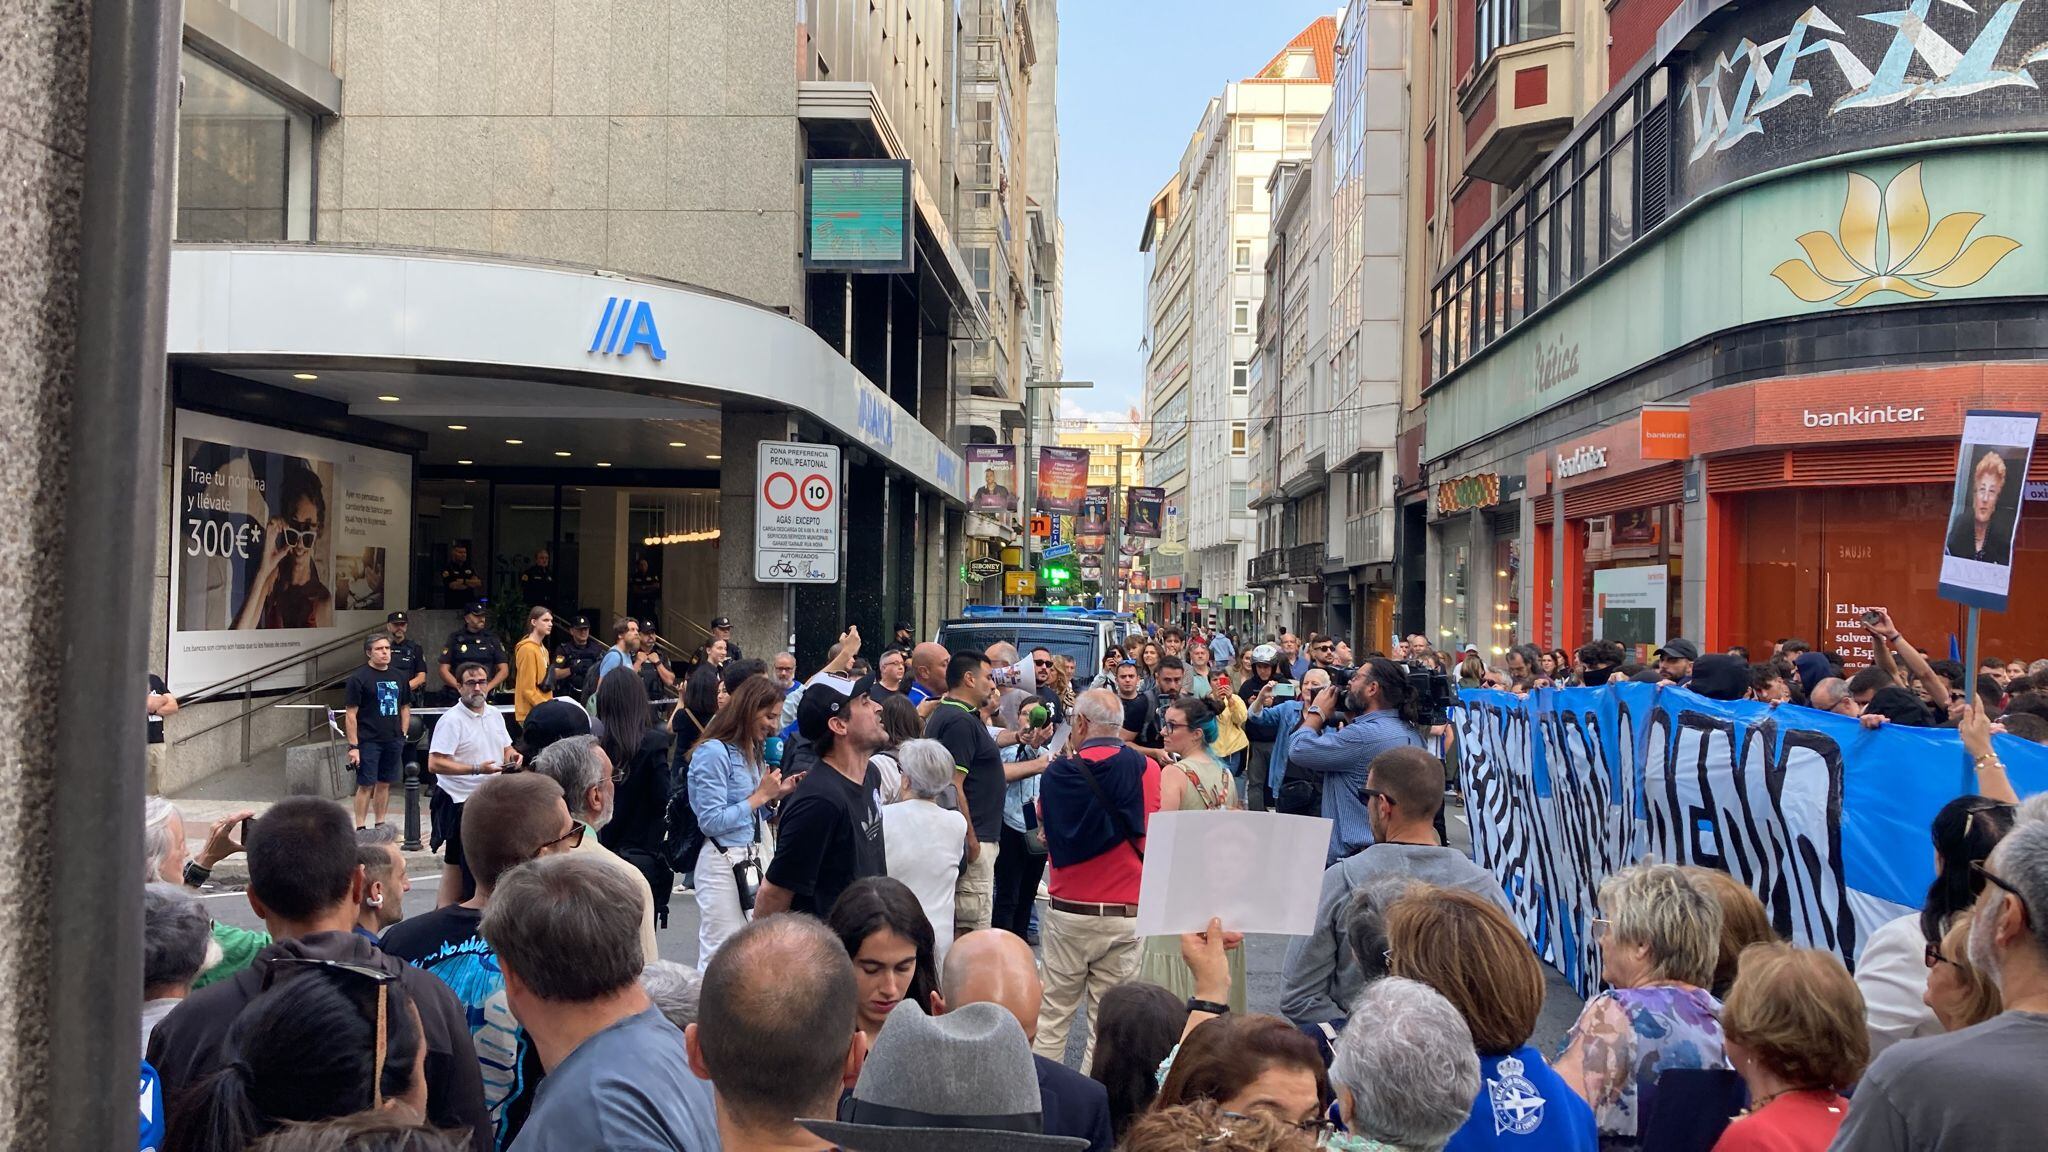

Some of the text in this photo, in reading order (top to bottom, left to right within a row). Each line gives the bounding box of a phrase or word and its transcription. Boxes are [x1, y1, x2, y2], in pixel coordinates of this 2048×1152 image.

[788, 449, 829, 458] PREFERENCIA
[188, 466, 266, 492] Trae tu nómina
[809, 486, 825, 500] 10
[187, 492, 232, 512] y llévate
[795, 517, 820, 526] EXCEPTO
[1836, 604, 1848, 614] El
[1836, 618, 1861, 628] más
[1836, 646, 1850, 657] de
